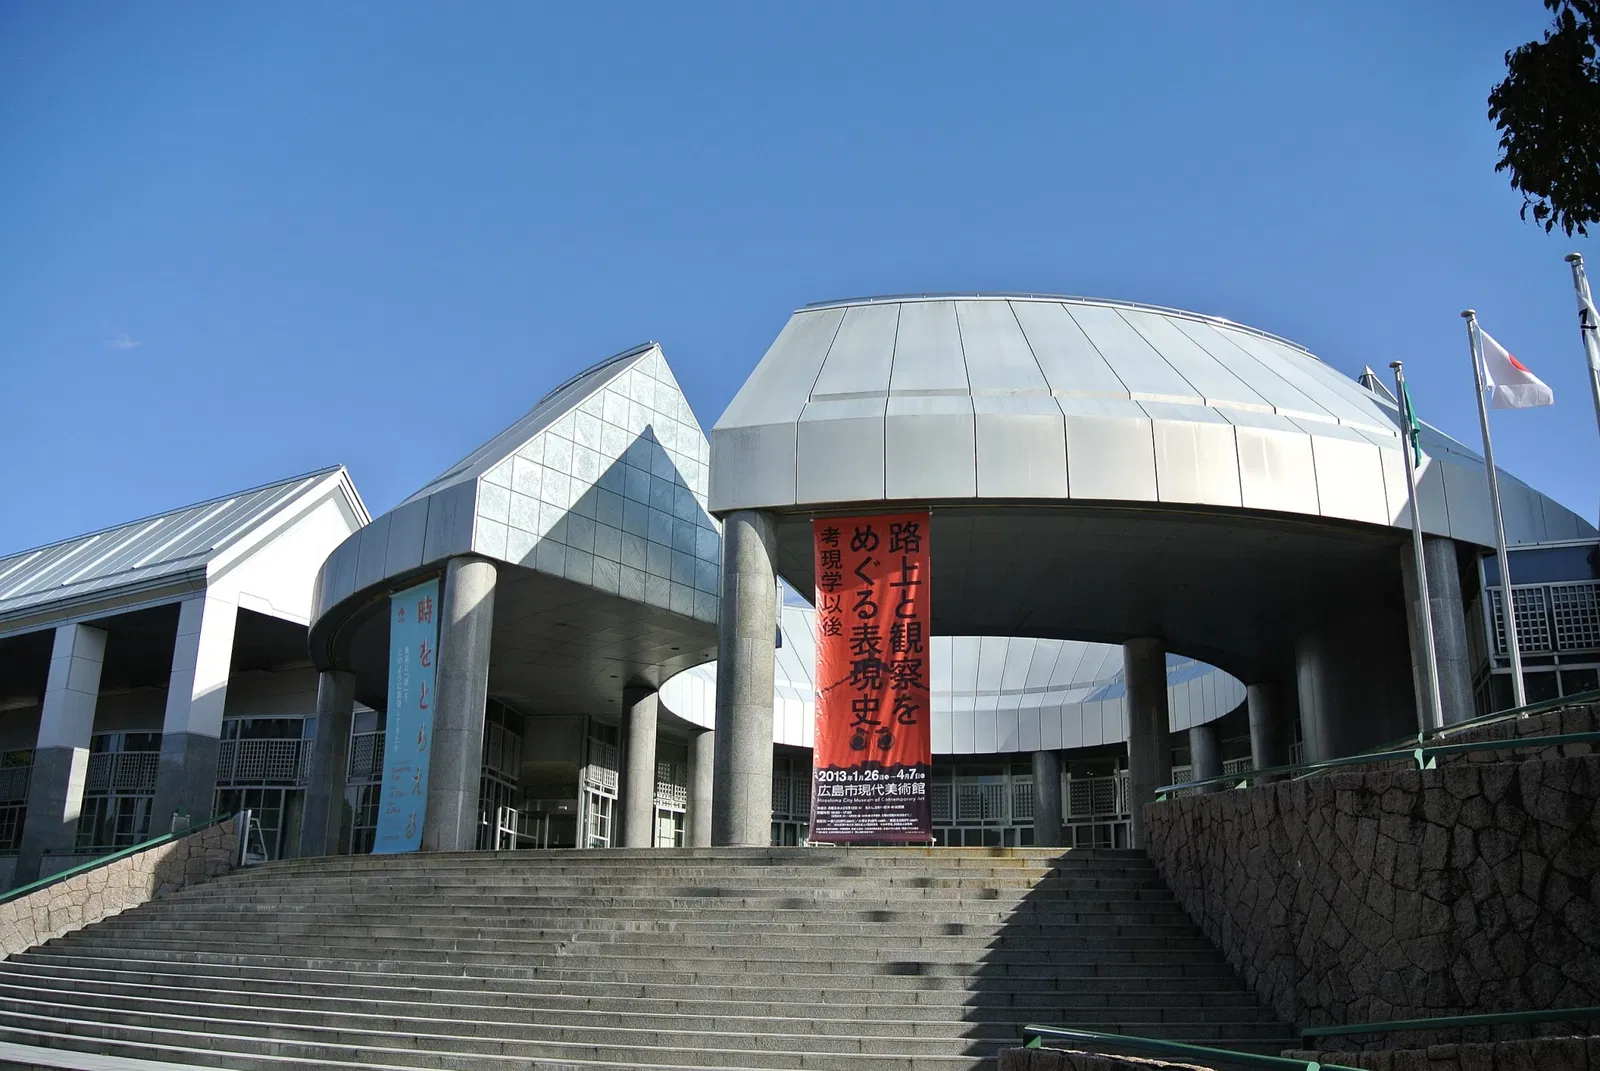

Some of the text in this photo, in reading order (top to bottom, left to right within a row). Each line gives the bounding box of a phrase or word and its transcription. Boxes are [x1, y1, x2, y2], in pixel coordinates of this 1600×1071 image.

[821, 526, 843, 637] 考現学以後
[849, 524, 883, 727] めぐる表現史
[888, 521, 923, 726] 路上と観察を
[405, 595, 433, 839] 時をとらえる
[817, 782, 925, 796] 広島市現代美術館
[881, 795, 916, 803] Contemporary
